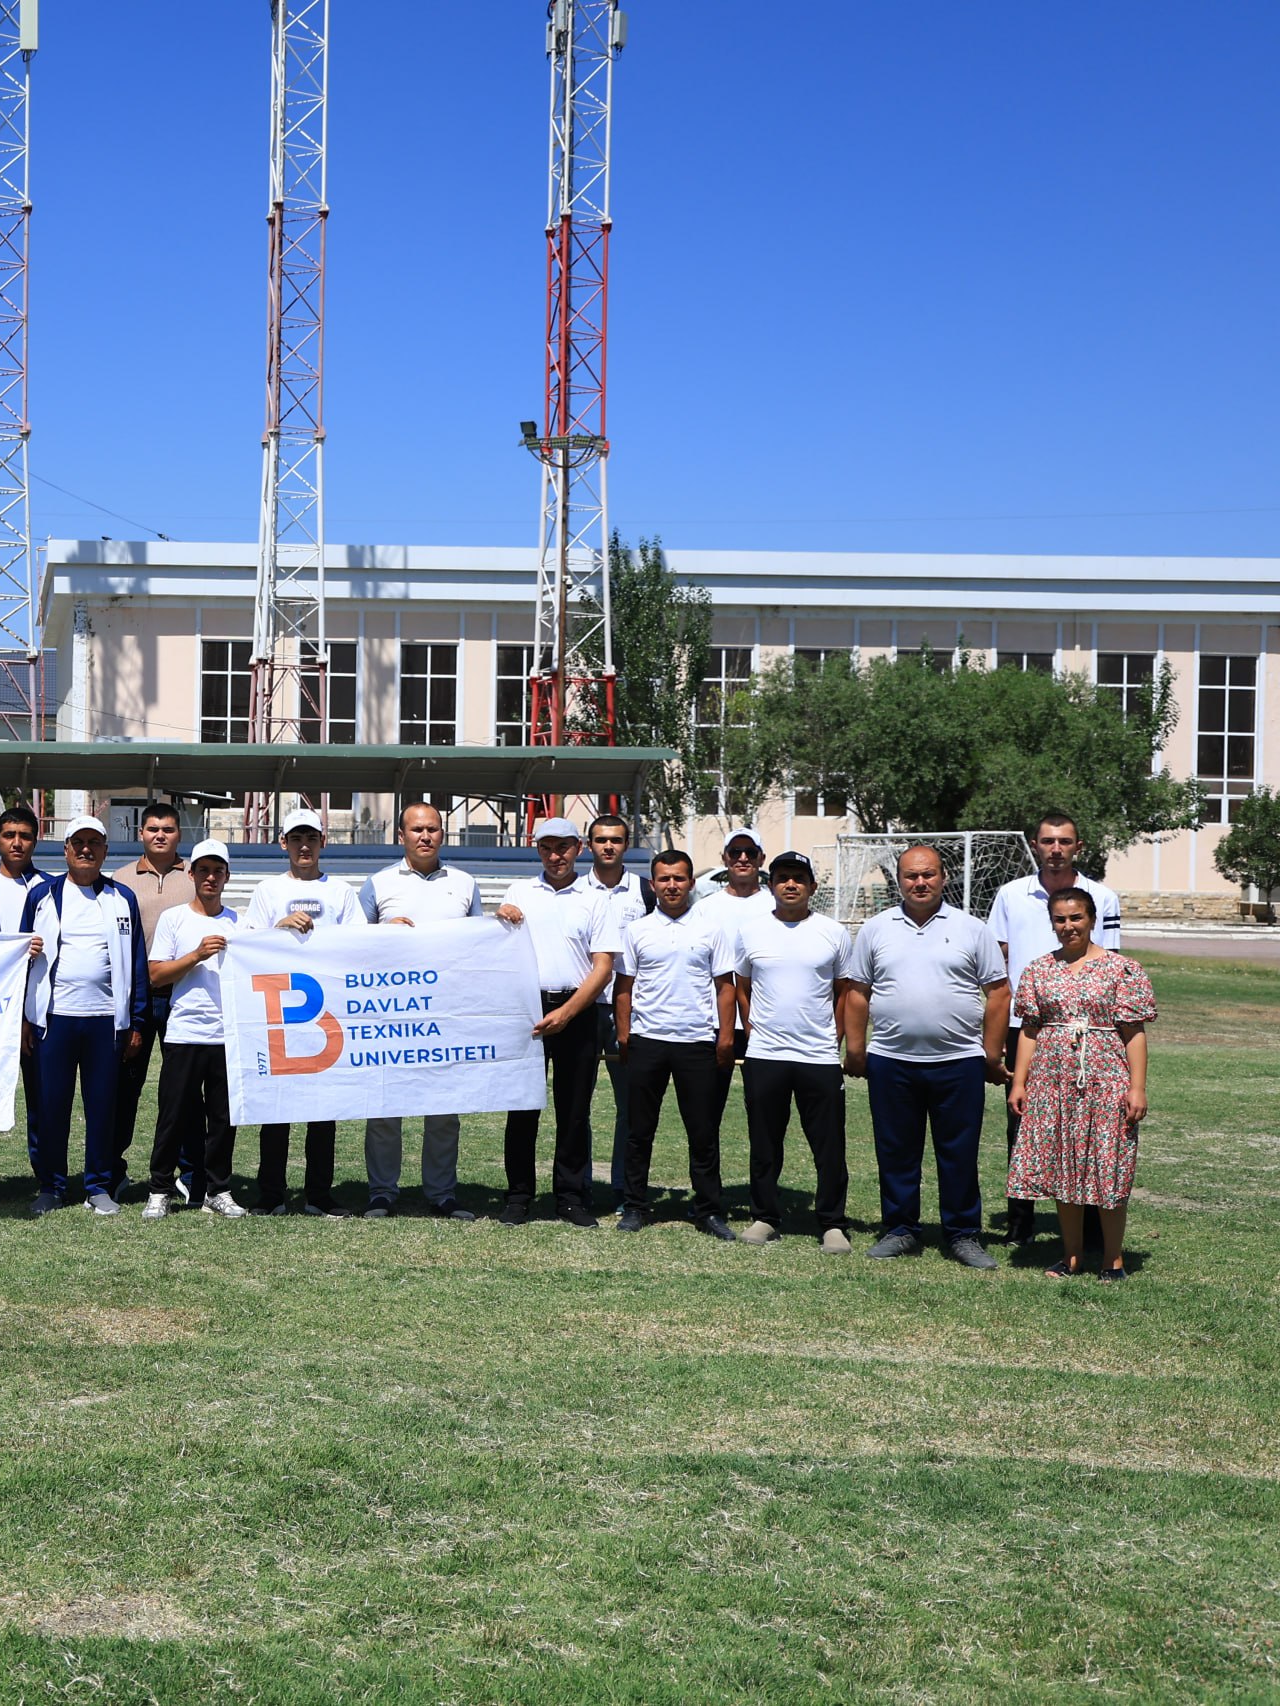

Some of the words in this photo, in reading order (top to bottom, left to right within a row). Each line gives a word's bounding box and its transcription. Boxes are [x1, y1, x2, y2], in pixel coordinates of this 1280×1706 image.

[290, 903, 321, 911] COURAGE
[345, 970, 438, 988] BUXORO
[346, 996, 433, 1014] DAVLAT
[347, 1022, 441, 1040] TEXNIKA
[257, 1051, 268, 1076] 1977
[350, 1045, 496, 1067] UNIVERSITETI
